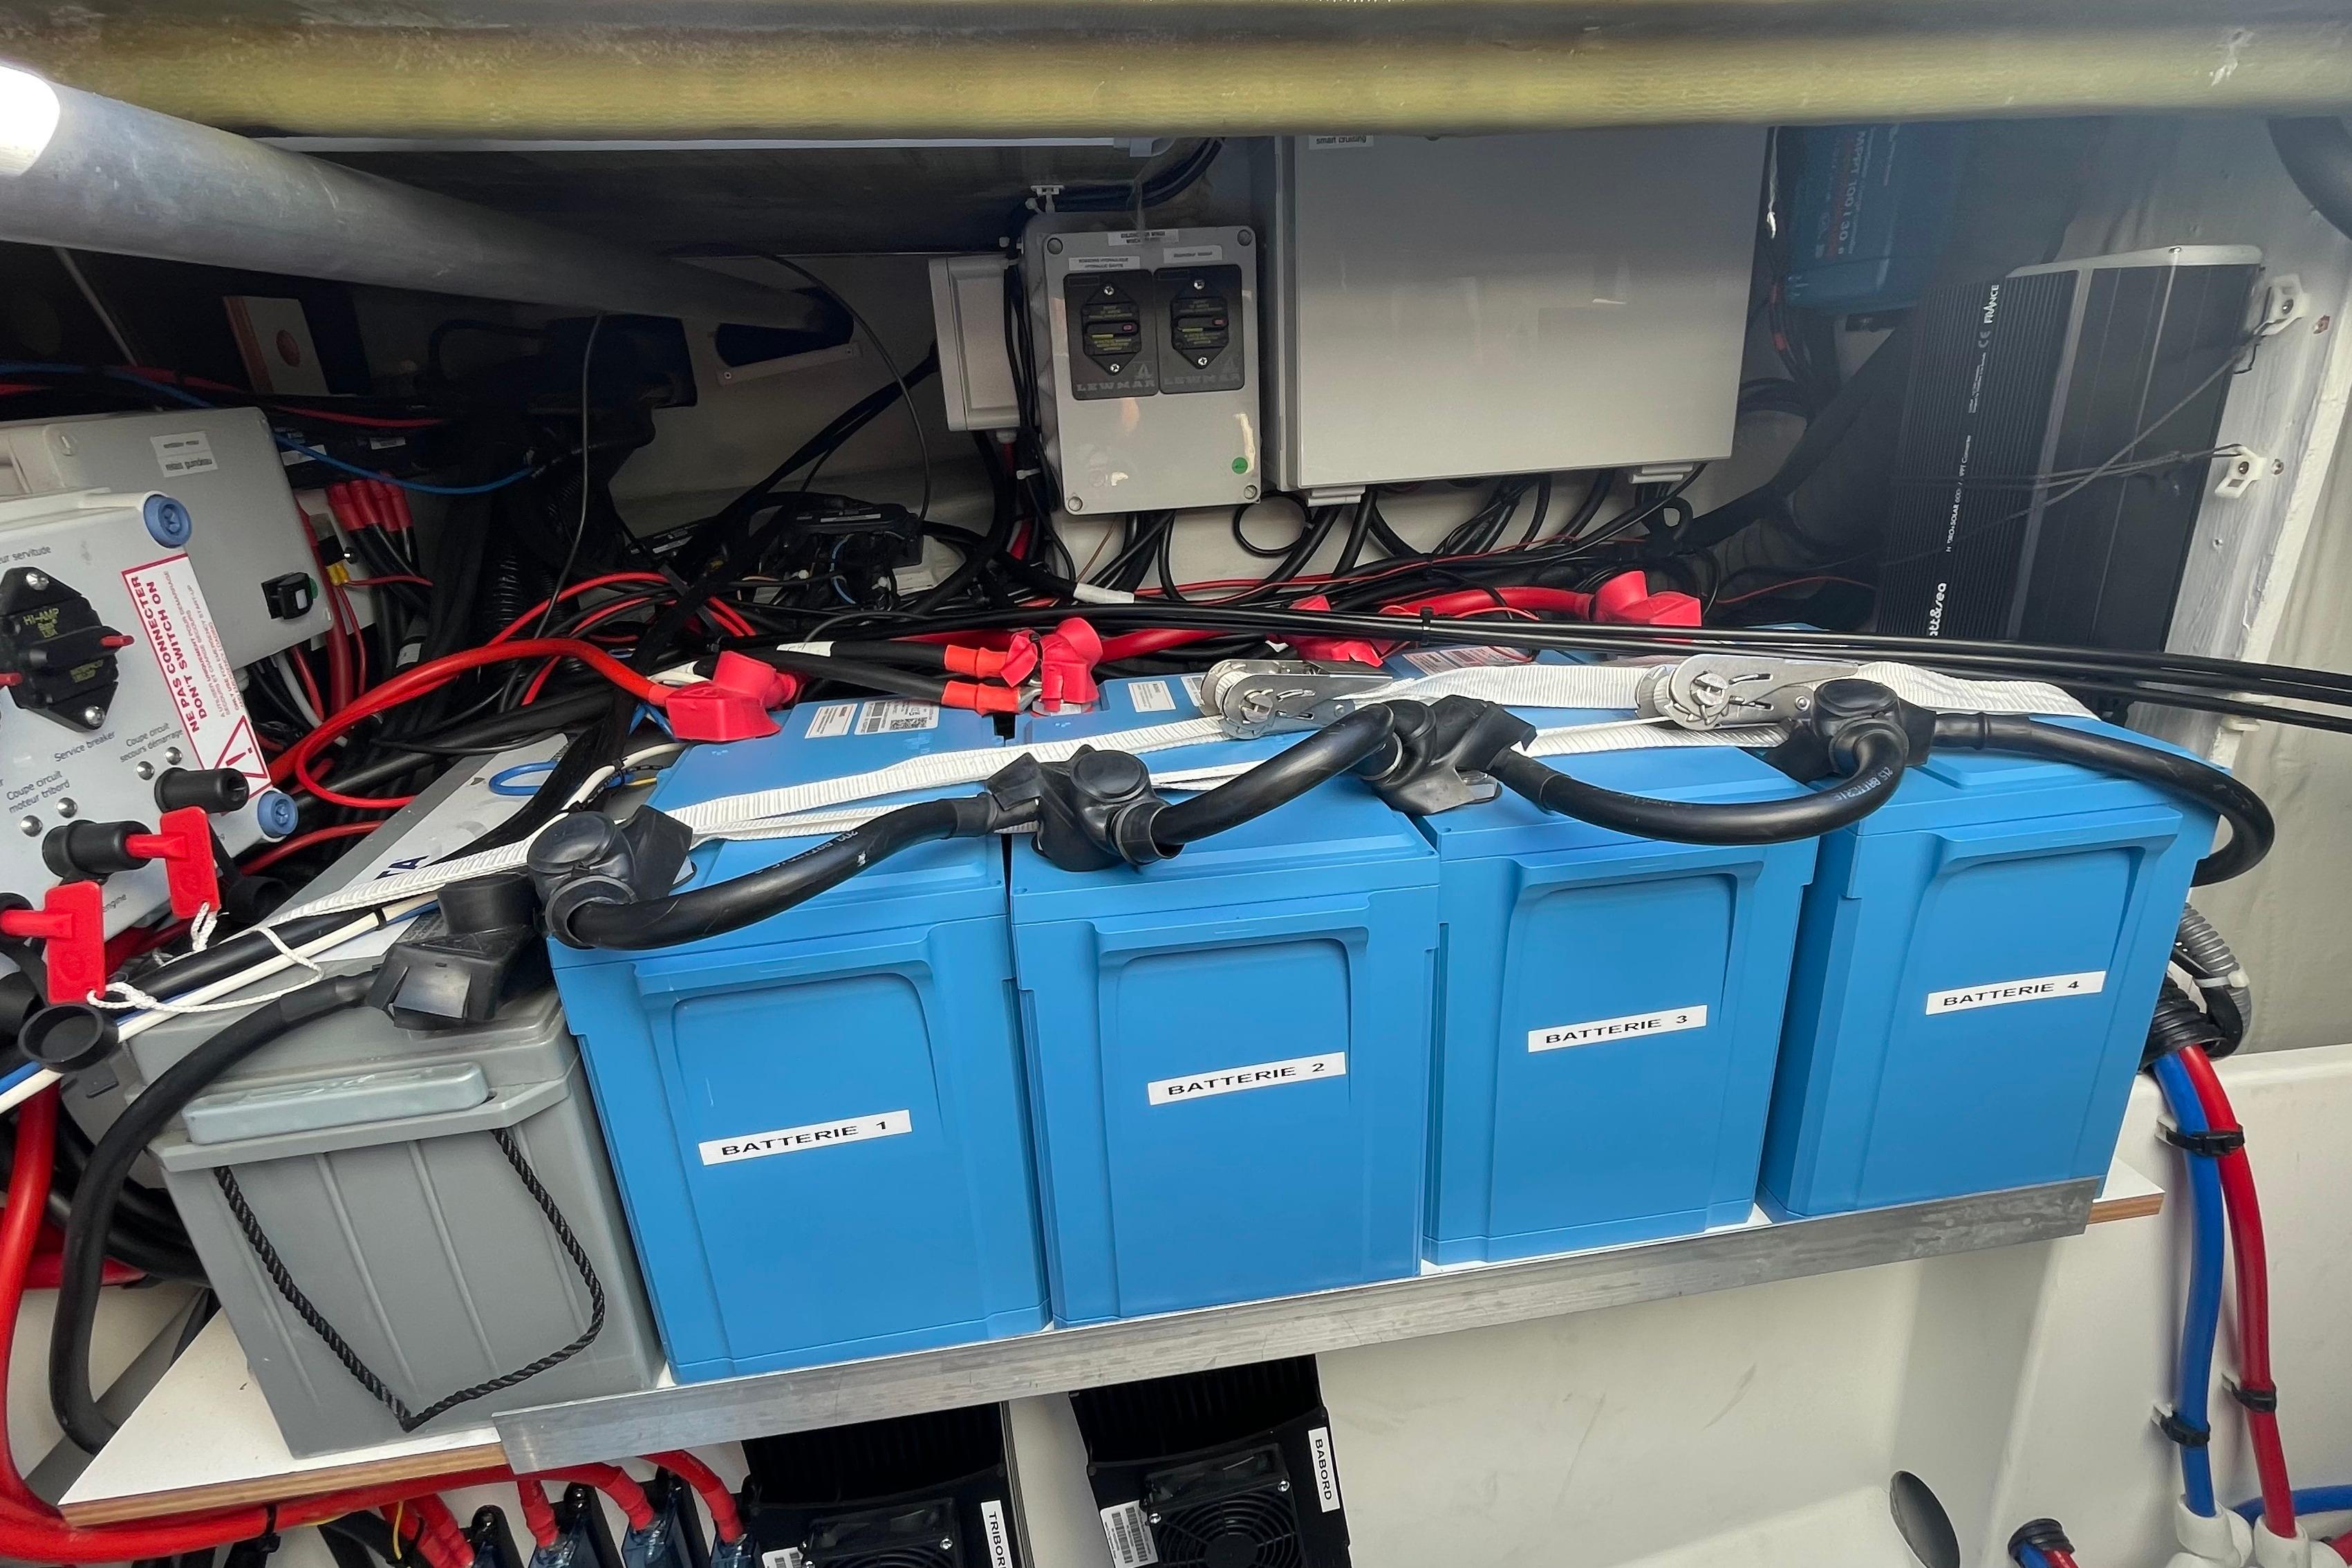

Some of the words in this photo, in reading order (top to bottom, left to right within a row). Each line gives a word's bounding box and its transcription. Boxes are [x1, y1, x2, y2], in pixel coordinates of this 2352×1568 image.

[1851, 131, 1866, 174] MPPT
[1844, 180, 1856, 207] 100
[1839, 220, 1850, 241] 30
[1983, 285, 1999, 324] FRANCE
[1076, 380, 1155, 391] LEWMAR
[1946, 504, 1959, 552] HDRO+SOLAR
[12, 546, 51, 561] servitude
[145, 580, 162, 605] ON
[163, 570, 185, 615] DEMARRAGE
[130, 575, 176, 675] CONNECTER
[157, 609, 187, 669] SWITCH
[181, 616, 193, 637] POUR
[185, 609, 202, 643] SECOURS
[190, 637, 211, 682] UNIQUEMENT
[171, 676, 190, 708] PAS
[183, 672, 207, 719] DON'T
[207, 682, 223, 711] UTILISER
[214, 683, 230, 716] SECOURS
[126, 732, 148, 747] Coupe
[149, 722, 169, 738] circuit
[185, 710, 200, 733] NE
[54, 744, 85, 762] Service
[86, 731, 116, 749] breaker
[120, 747, 147, 763] secours
[148, 729, 183, 750] démarrage
[6, 783, 35, 801] Coupe
[36, 770, 63, 788] circuit
[8, 794, 39, 814] moteur
[41, 778, 70, 799] tribord
[1833, 777, 1881, 801] BATTERIE
[1943, 982, 2055, 1007] BATTERIE
[1546, 1018, 1661, 1043] BATTERIE
[1676, 1015, 1688, 1024] 3
[1168, 1067, 1296, 1095] BATTERIE
[1312, 1063, 1325, 1072] 2
[722, 1126, 859, 1155] BATTERIE
[876, 1121, 886, 1130] 1
[1315, 1439, 1332, 1500] BABORD
[989, 1511, 1007, 1568] TRIBOR
